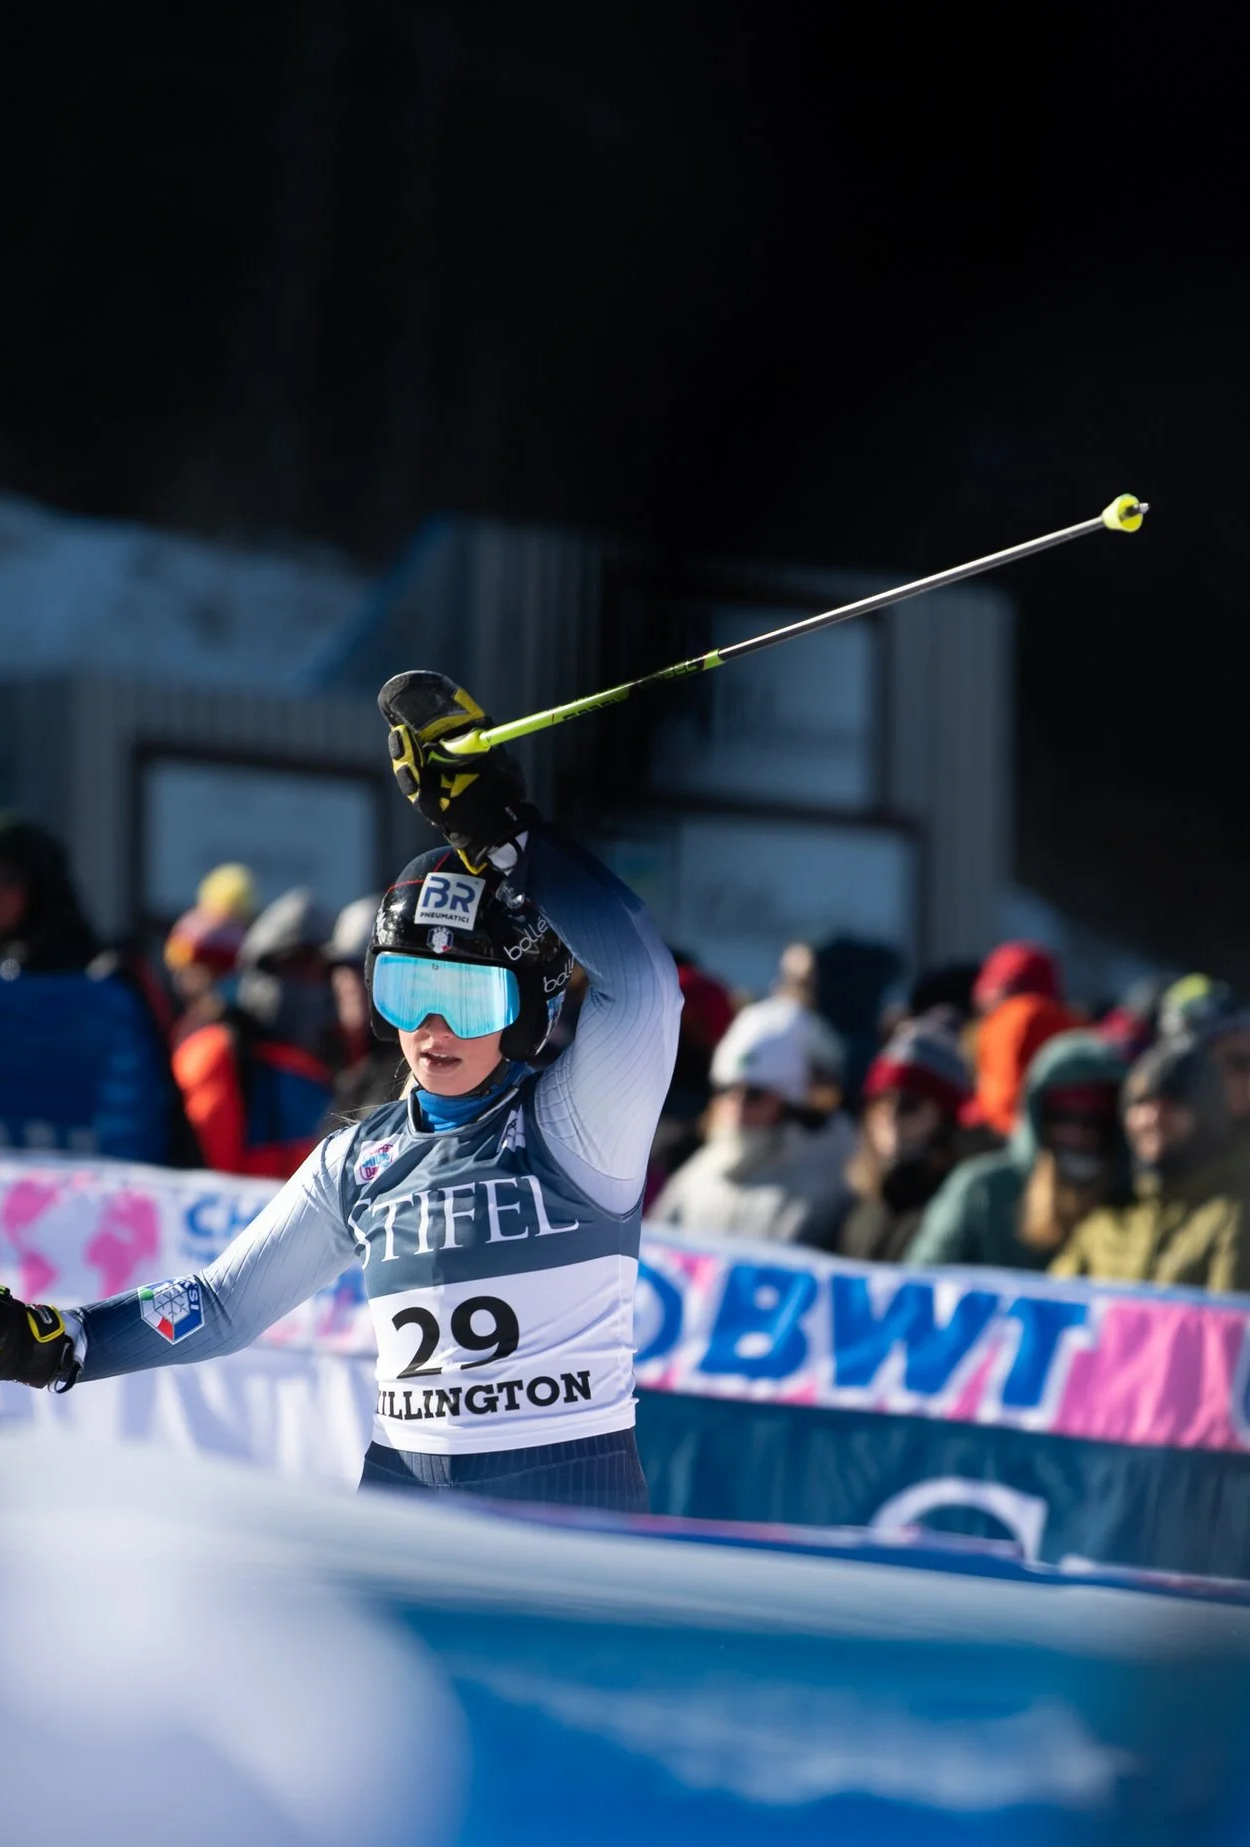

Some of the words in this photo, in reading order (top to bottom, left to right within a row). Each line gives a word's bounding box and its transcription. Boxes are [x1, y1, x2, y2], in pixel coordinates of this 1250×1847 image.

[420, 911, 470, 924] PNEUMATICI
[422, 876, 475, 913] BR
[503, 915, 548, 961] bollé
[543, 955, 575, 993] boll
[348, 1175, 579, 1271] STIFEL
[391, 1295, 519, 1379] 29
[701, 1264, 1088, 1407] BWT
[377, 1370, 592, 1420] ILLINGTON
